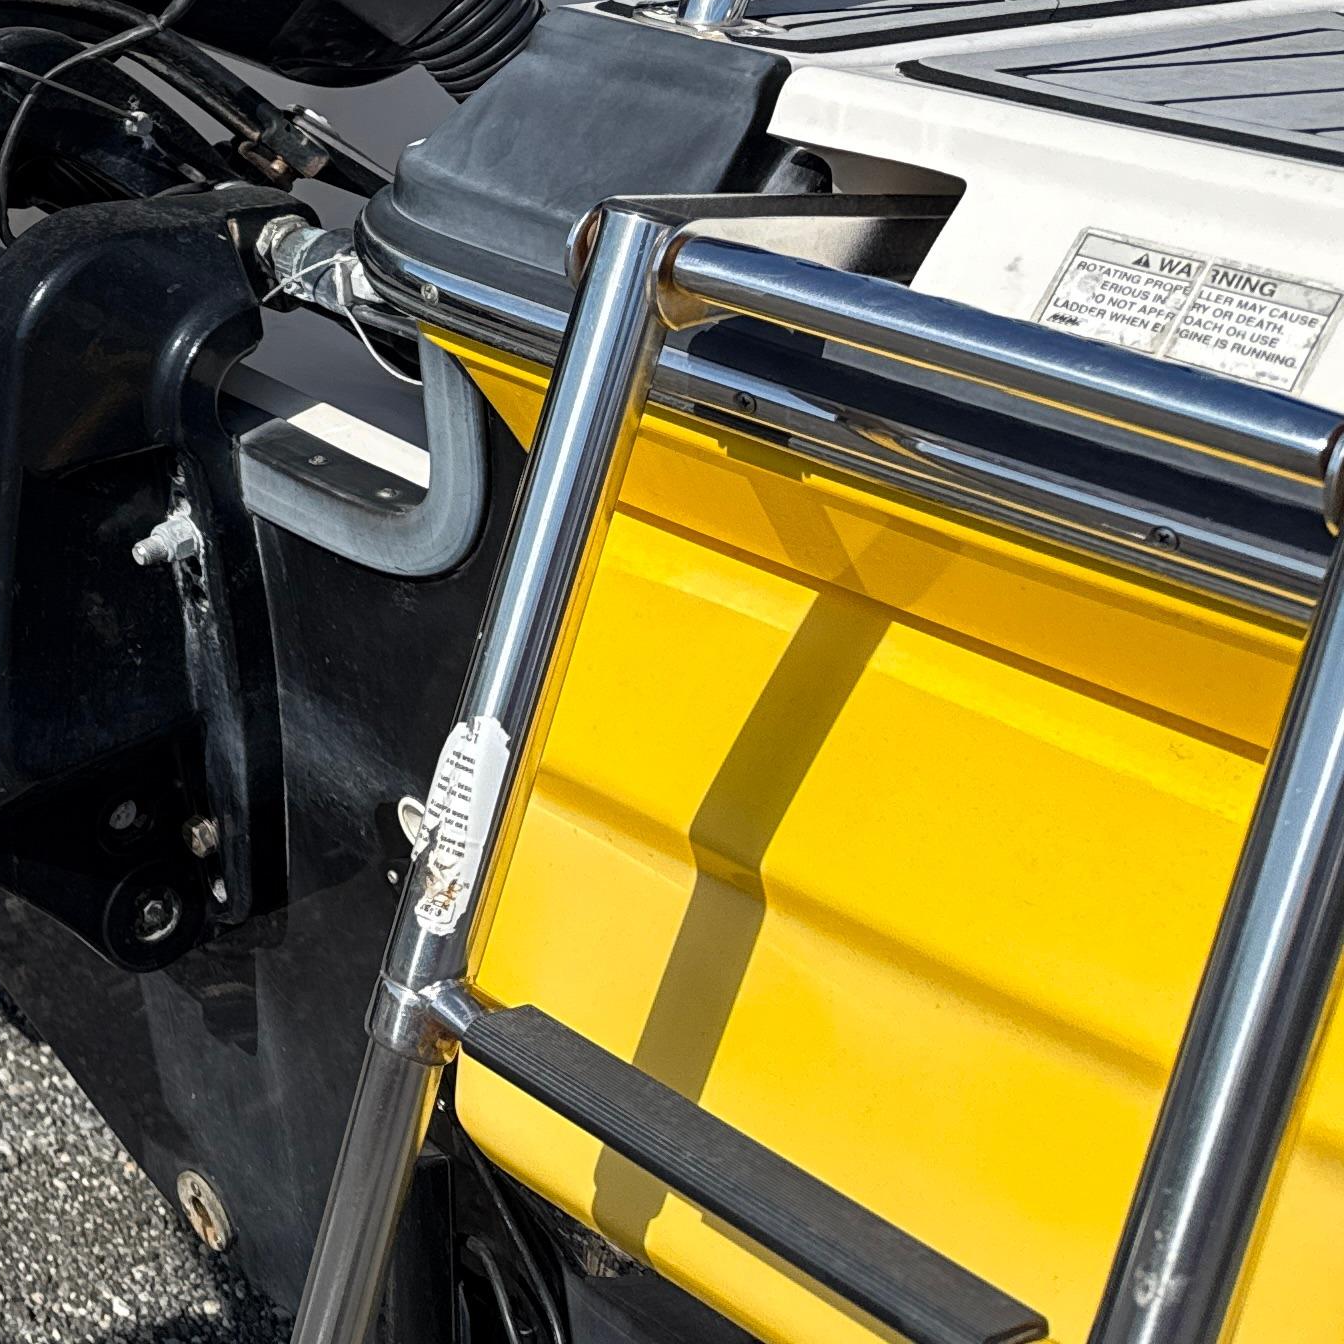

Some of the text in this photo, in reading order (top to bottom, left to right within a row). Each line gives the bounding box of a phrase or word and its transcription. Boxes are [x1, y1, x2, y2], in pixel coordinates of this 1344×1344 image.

[1076, 260, 1319, 329] ROTATING PROPELLER MAY CAUSE
[1159, 256, 1278, 297] WARNING
[1053, 297, 1107, 319] LADDER
[1109, 311, 1150, 329] WHEN
[1213, 338, 1229, 350] IS
[1230, 342, 1298, 369] RUNNING.
[1099, 280, 1284, 336] ERIOUS INRY OR DEATH.
[1107, 296, 1137, 311] NOT
[1226, 325, 1247, 341] OR
[1249, 331, 1280, 349] USE
